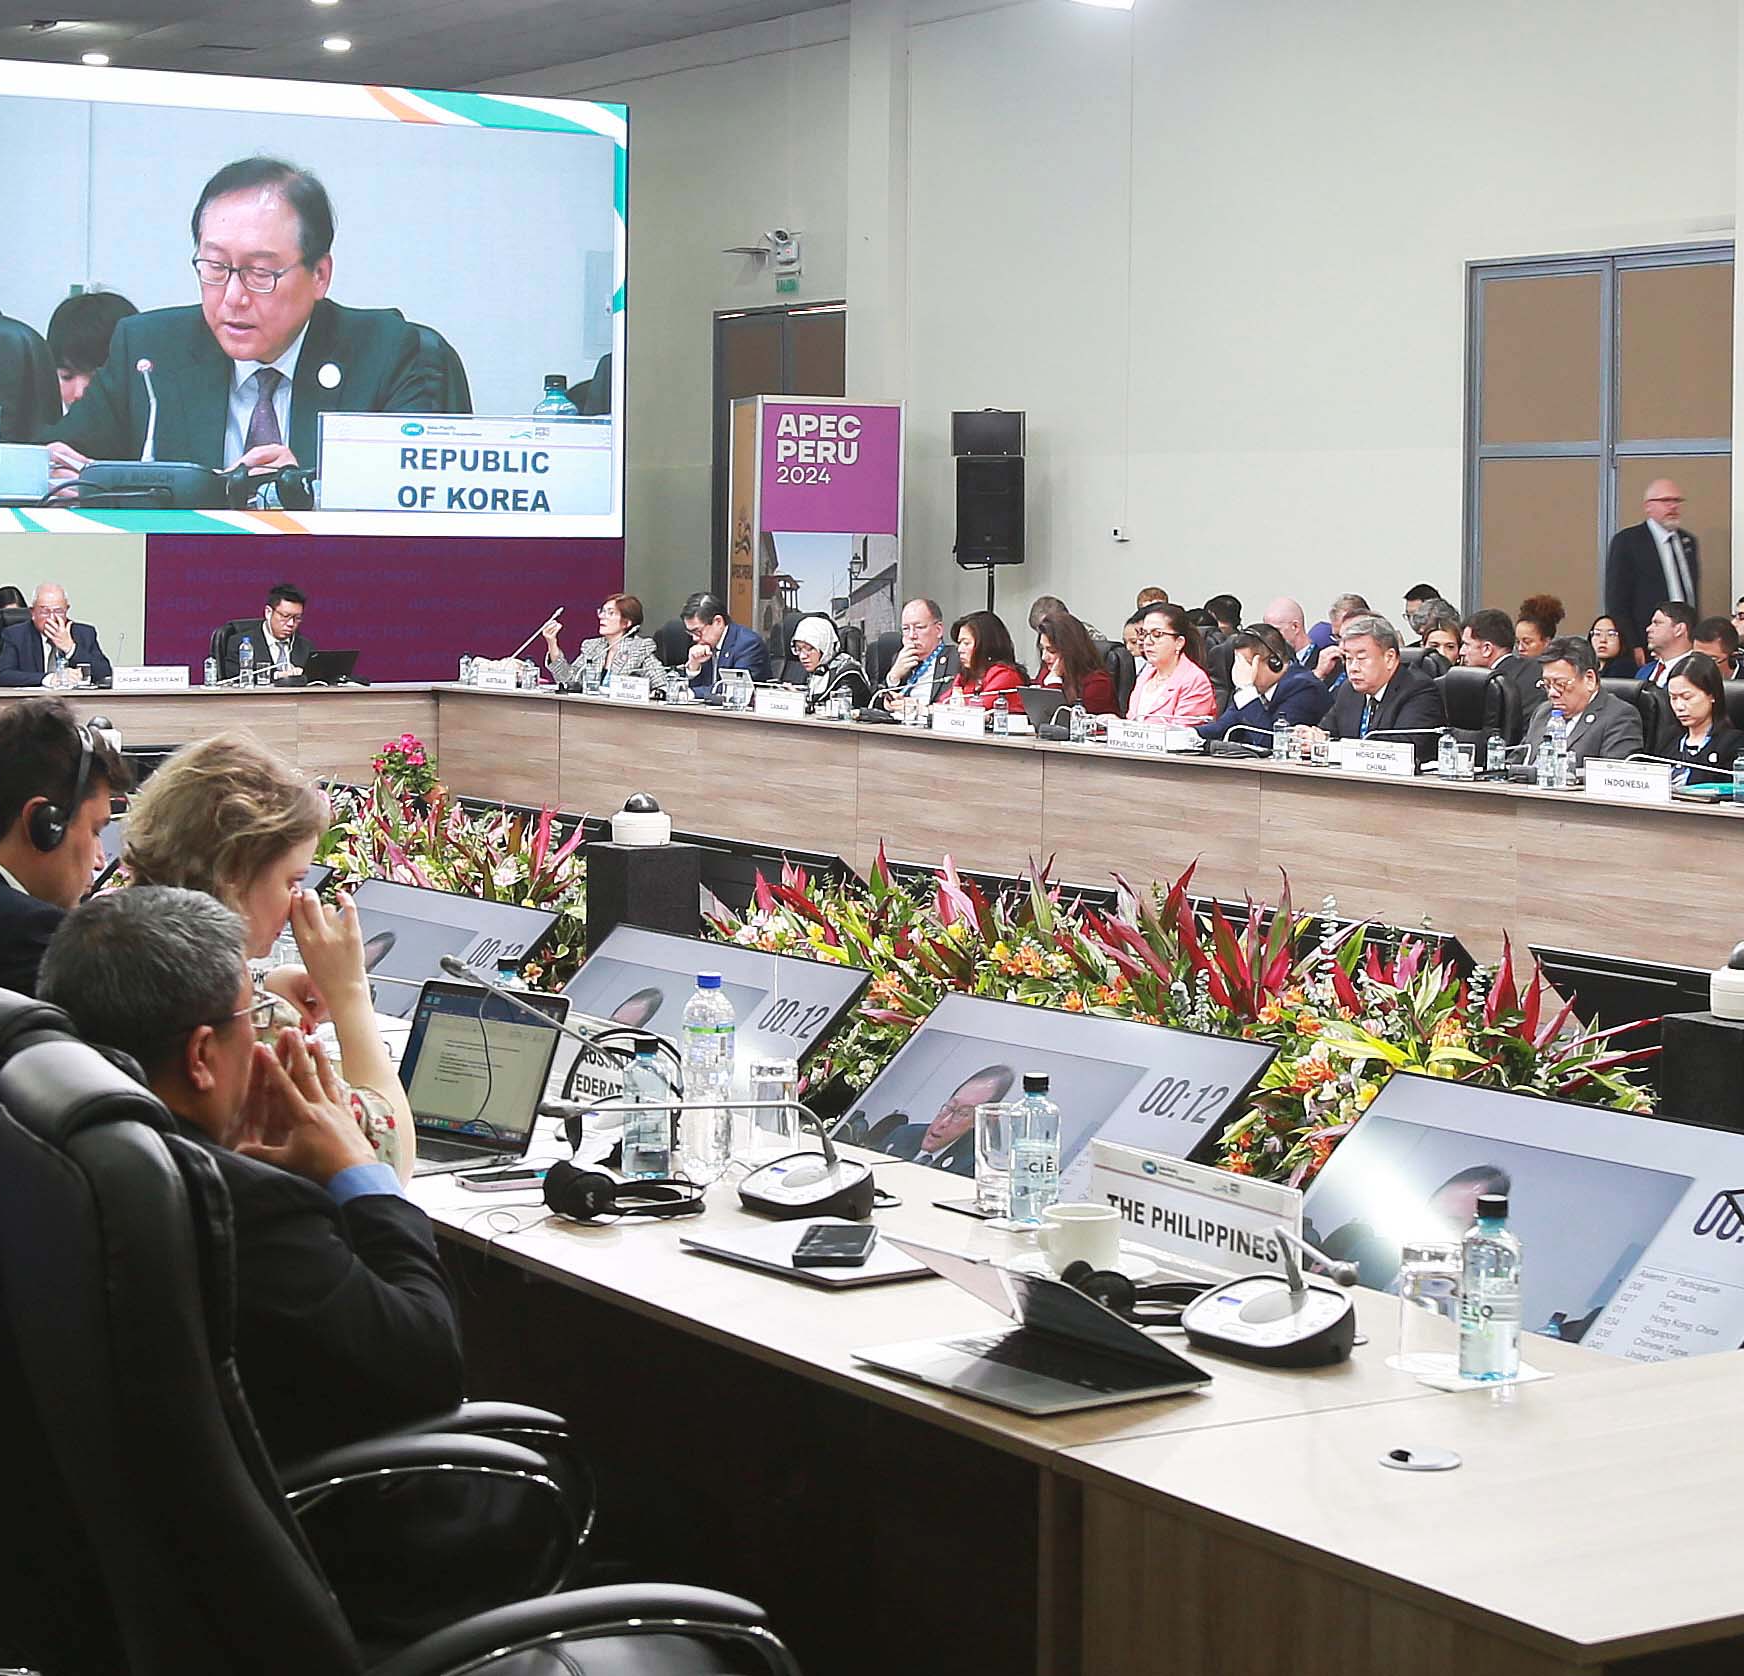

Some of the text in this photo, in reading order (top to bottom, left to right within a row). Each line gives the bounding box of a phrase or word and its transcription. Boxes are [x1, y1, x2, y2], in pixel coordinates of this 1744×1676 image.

[777, 413, 861, 439] APEC
[400, 447, 550, 474] REPUBLIC
[777, 440, 858, 465] PERU
[776, 466, 832, 484] 2024
[398, 486, 551, 513] OF KOREA
[1604, 778, 1650, 790] INDONESIA
[758, 998, 830, 1039] 00:12
[575, 1073, 624, 1098] EDERAT
[1138, 1076, 1230, 1124] 00:12
[1106, 1193, 1278, 1264] THE PHILIPPINES
